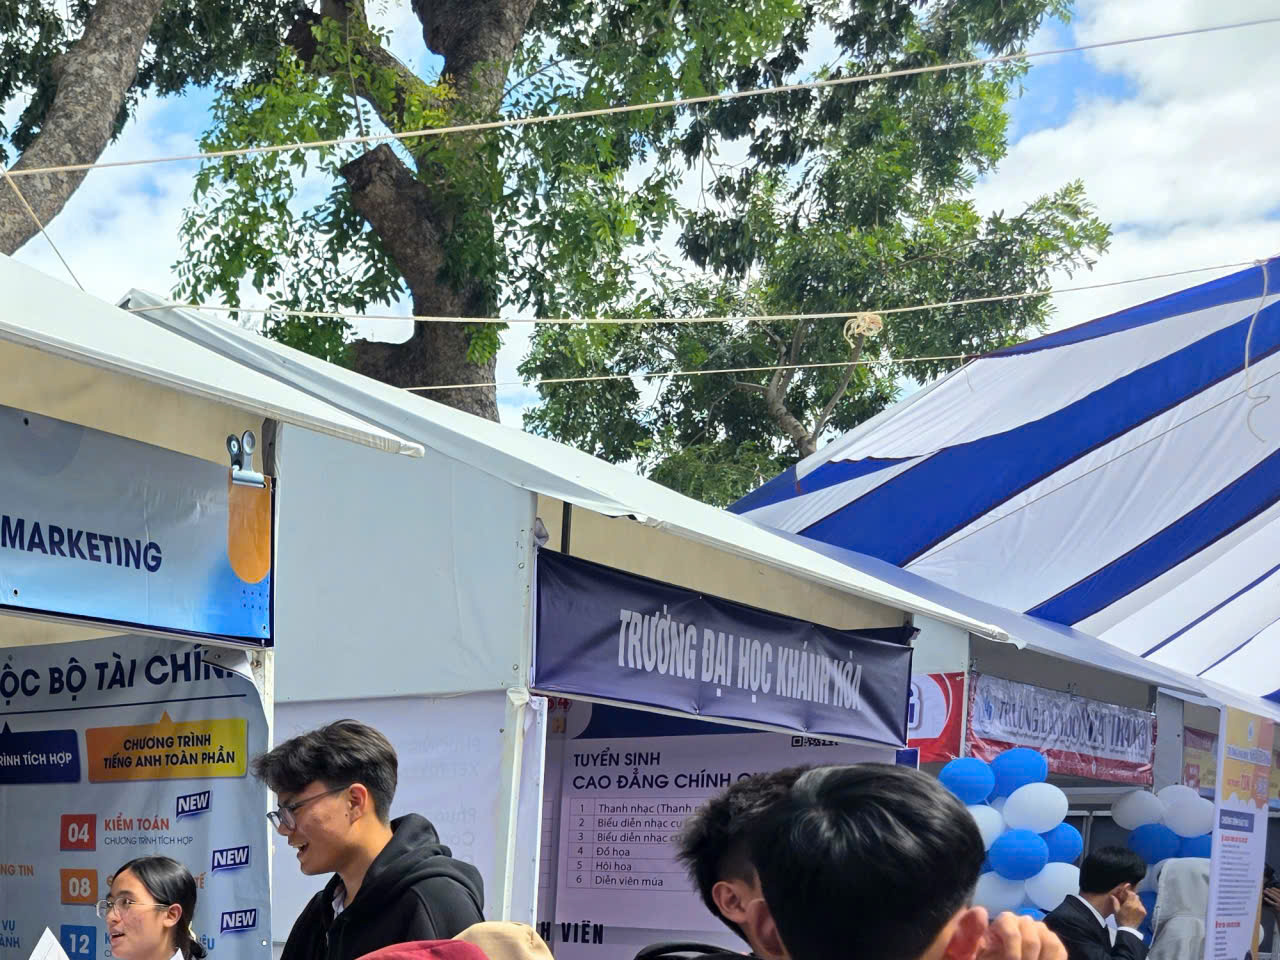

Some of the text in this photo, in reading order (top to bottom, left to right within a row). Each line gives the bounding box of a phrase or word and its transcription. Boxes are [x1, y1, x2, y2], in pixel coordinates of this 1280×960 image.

[1, 515, 163, 573] MARKETING
[618, 605, 863, 711] TRƯỜNG ĐẠI HỌC KHÁNH HÒA
[48, 657, 86, 701] BỘ
[94, 652, 137, 692] TÀI
[123, 732, 212, 751] CHƯƠNG TRÌNH
[22, 751, 48, 767] TÍCH
[50, 752, 73, 768] HỢP
[103, 745, 236, 770] TIẾNG ANH TOÀN PHẦN
[574, 746, 661, 768] TUYỂN SINH
[572, 775, 612, 790] CAO
[616, 768, 670, 790] ĐẲNG
[674, 769, 732, 789] CHÍNH
[178, 792, 209, 814] NEW
[598, 803, 654, 815] Thanh nhạc
[104, 813, 169, 832] KIỂM TOÁN
[67, 823, 91, 844] 04
[213, 847, 249, 867] NEW
[69, 877, 91, 897] 08
[619, 876, 640, 886] viên
[641, 877, 664, 887] múa
[223, 911, 256, 929] NEW
